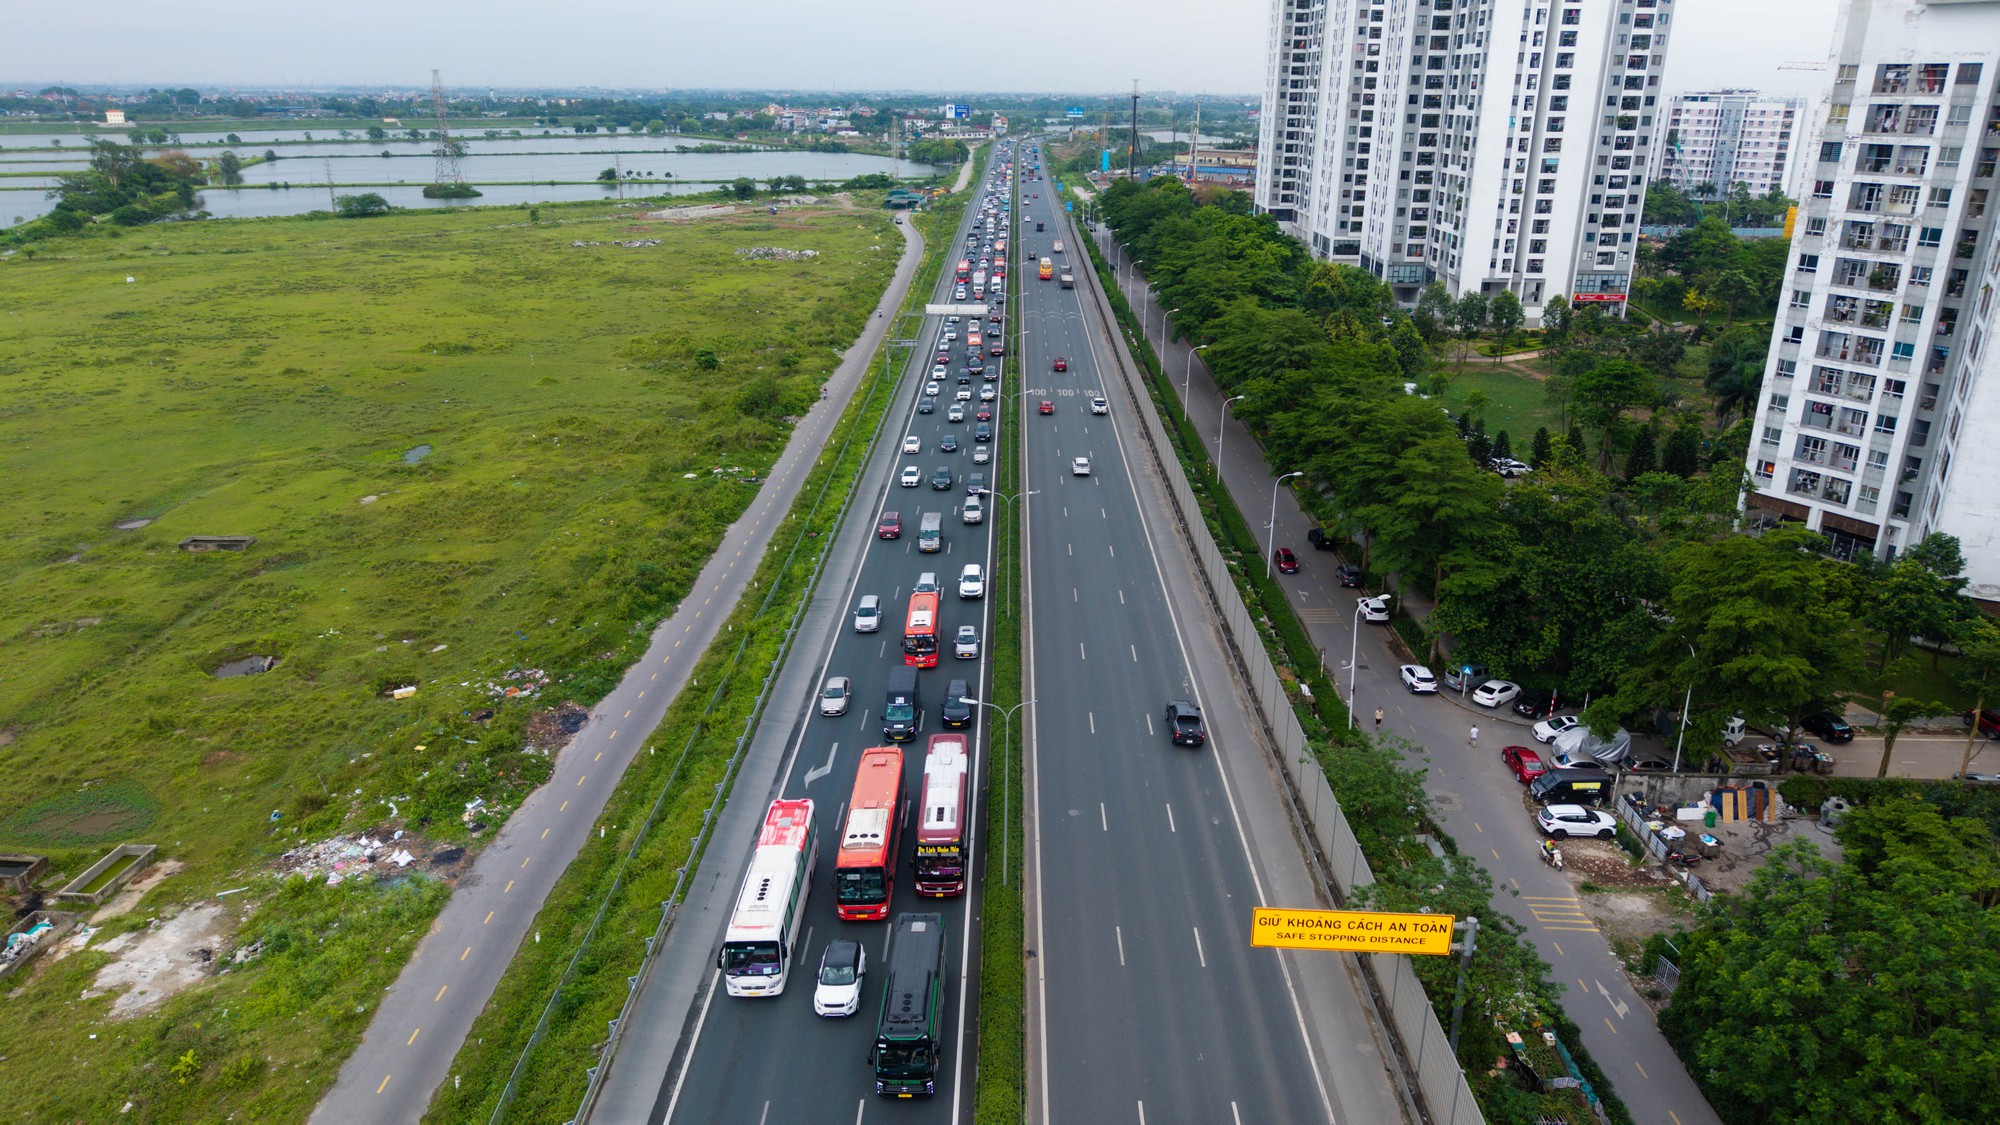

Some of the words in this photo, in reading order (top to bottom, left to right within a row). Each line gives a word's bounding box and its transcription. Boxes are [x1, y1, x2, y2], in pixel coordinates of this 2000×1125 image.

[1031, 388, 1047, 396] 100
[1057, 388, 1074, 397] 100
[1083, 389, 1100, 397] 100
[1258, 914, 1282, 926] GIỮ
[1287, 916, 1342, 930] KHOẢNG
[1347, 918, 1383, 931] CÁCH
[1388, 922, 1407, 932] AN
[1413, 920, 1448, 933] TOÀN
[1276, 932, 1305, 940] SAFE
[1309, 933, 1366, 942] STOPPING
[1370, 936, 1427, 945] DISTANCE
